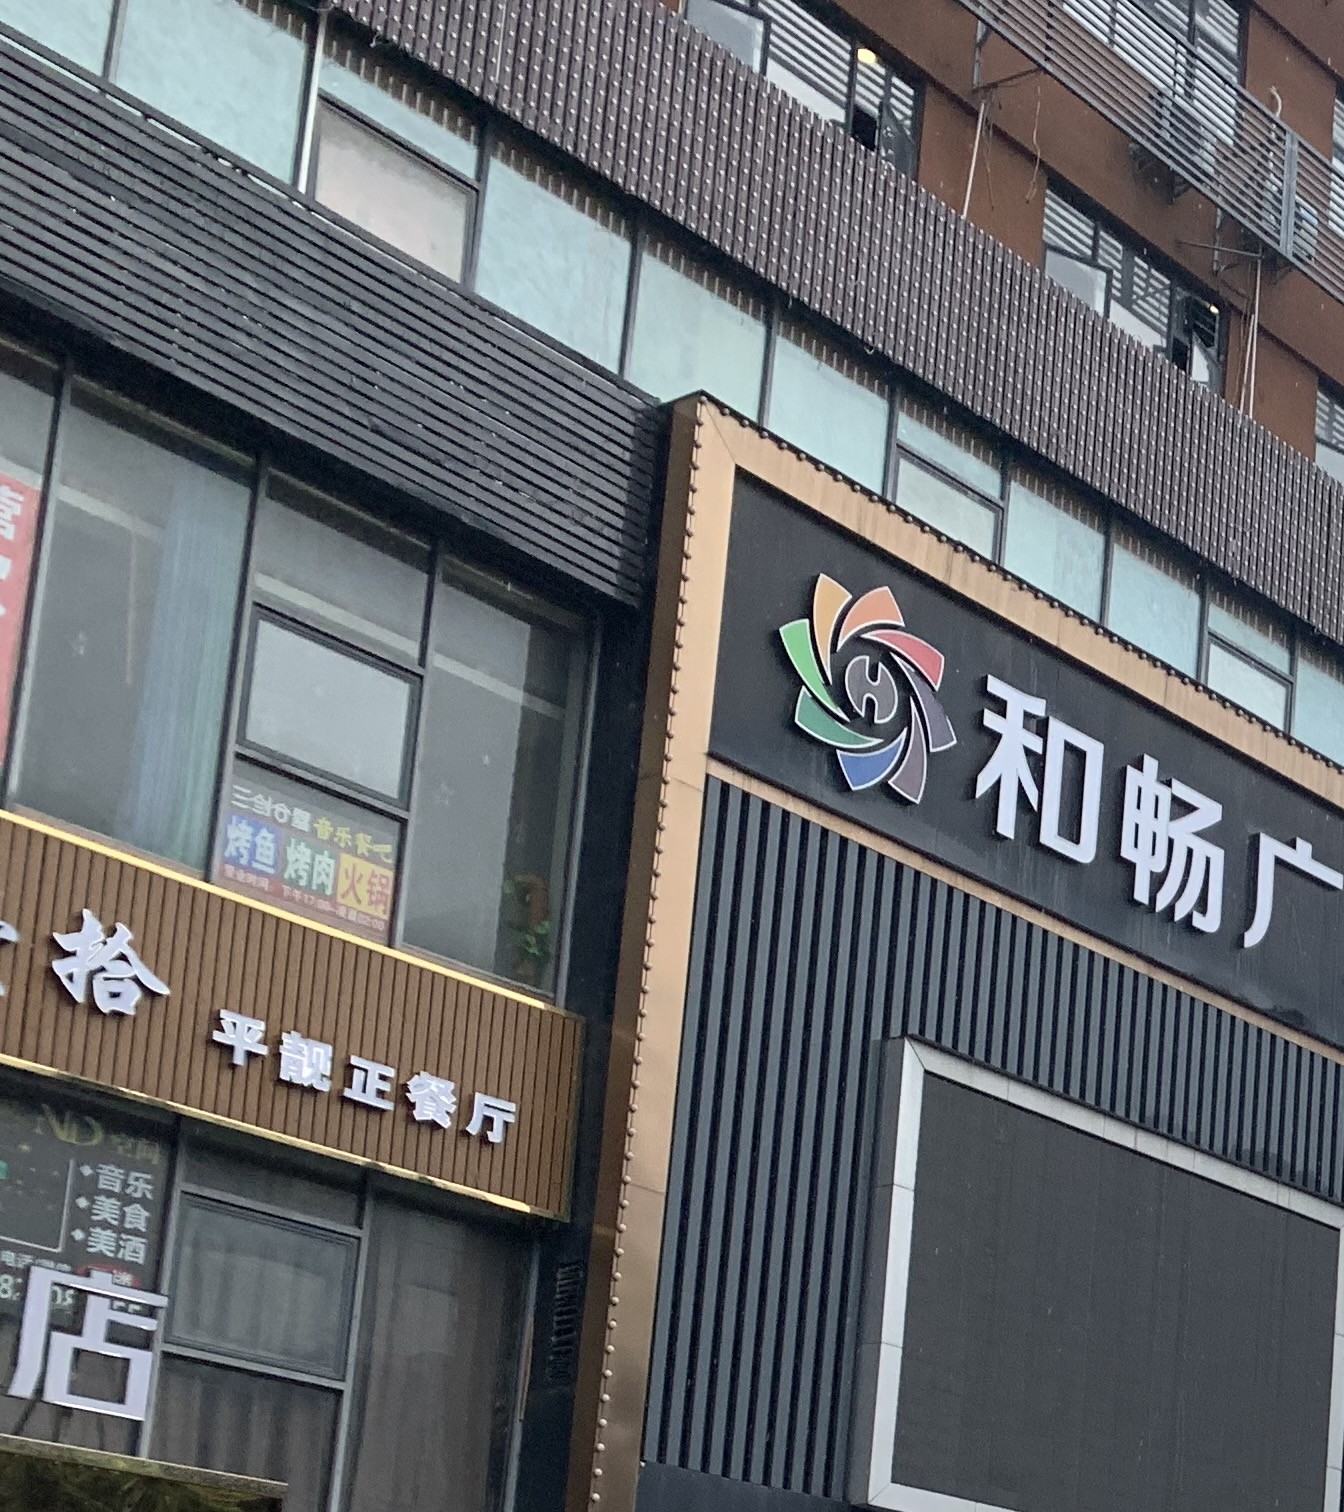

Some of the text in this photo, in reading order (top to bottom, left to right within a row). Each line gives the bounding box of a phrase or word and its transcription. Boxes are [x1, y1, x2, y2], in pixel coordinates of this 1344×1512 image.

[224, 814, 276, 875] 烤鱼
[283, 837, 336, 896] 烤肉
[0, 908, 170, 1016] 拾
[211, 1008, 517, 1145] 平靓正餐厅
[91, 1195, 150, 1233] 美食
[96, 1163, 153, 1200] 音乐
[86, 1226, 148, 1266] 美酒
[8, 1264, 169, 1421] 店
